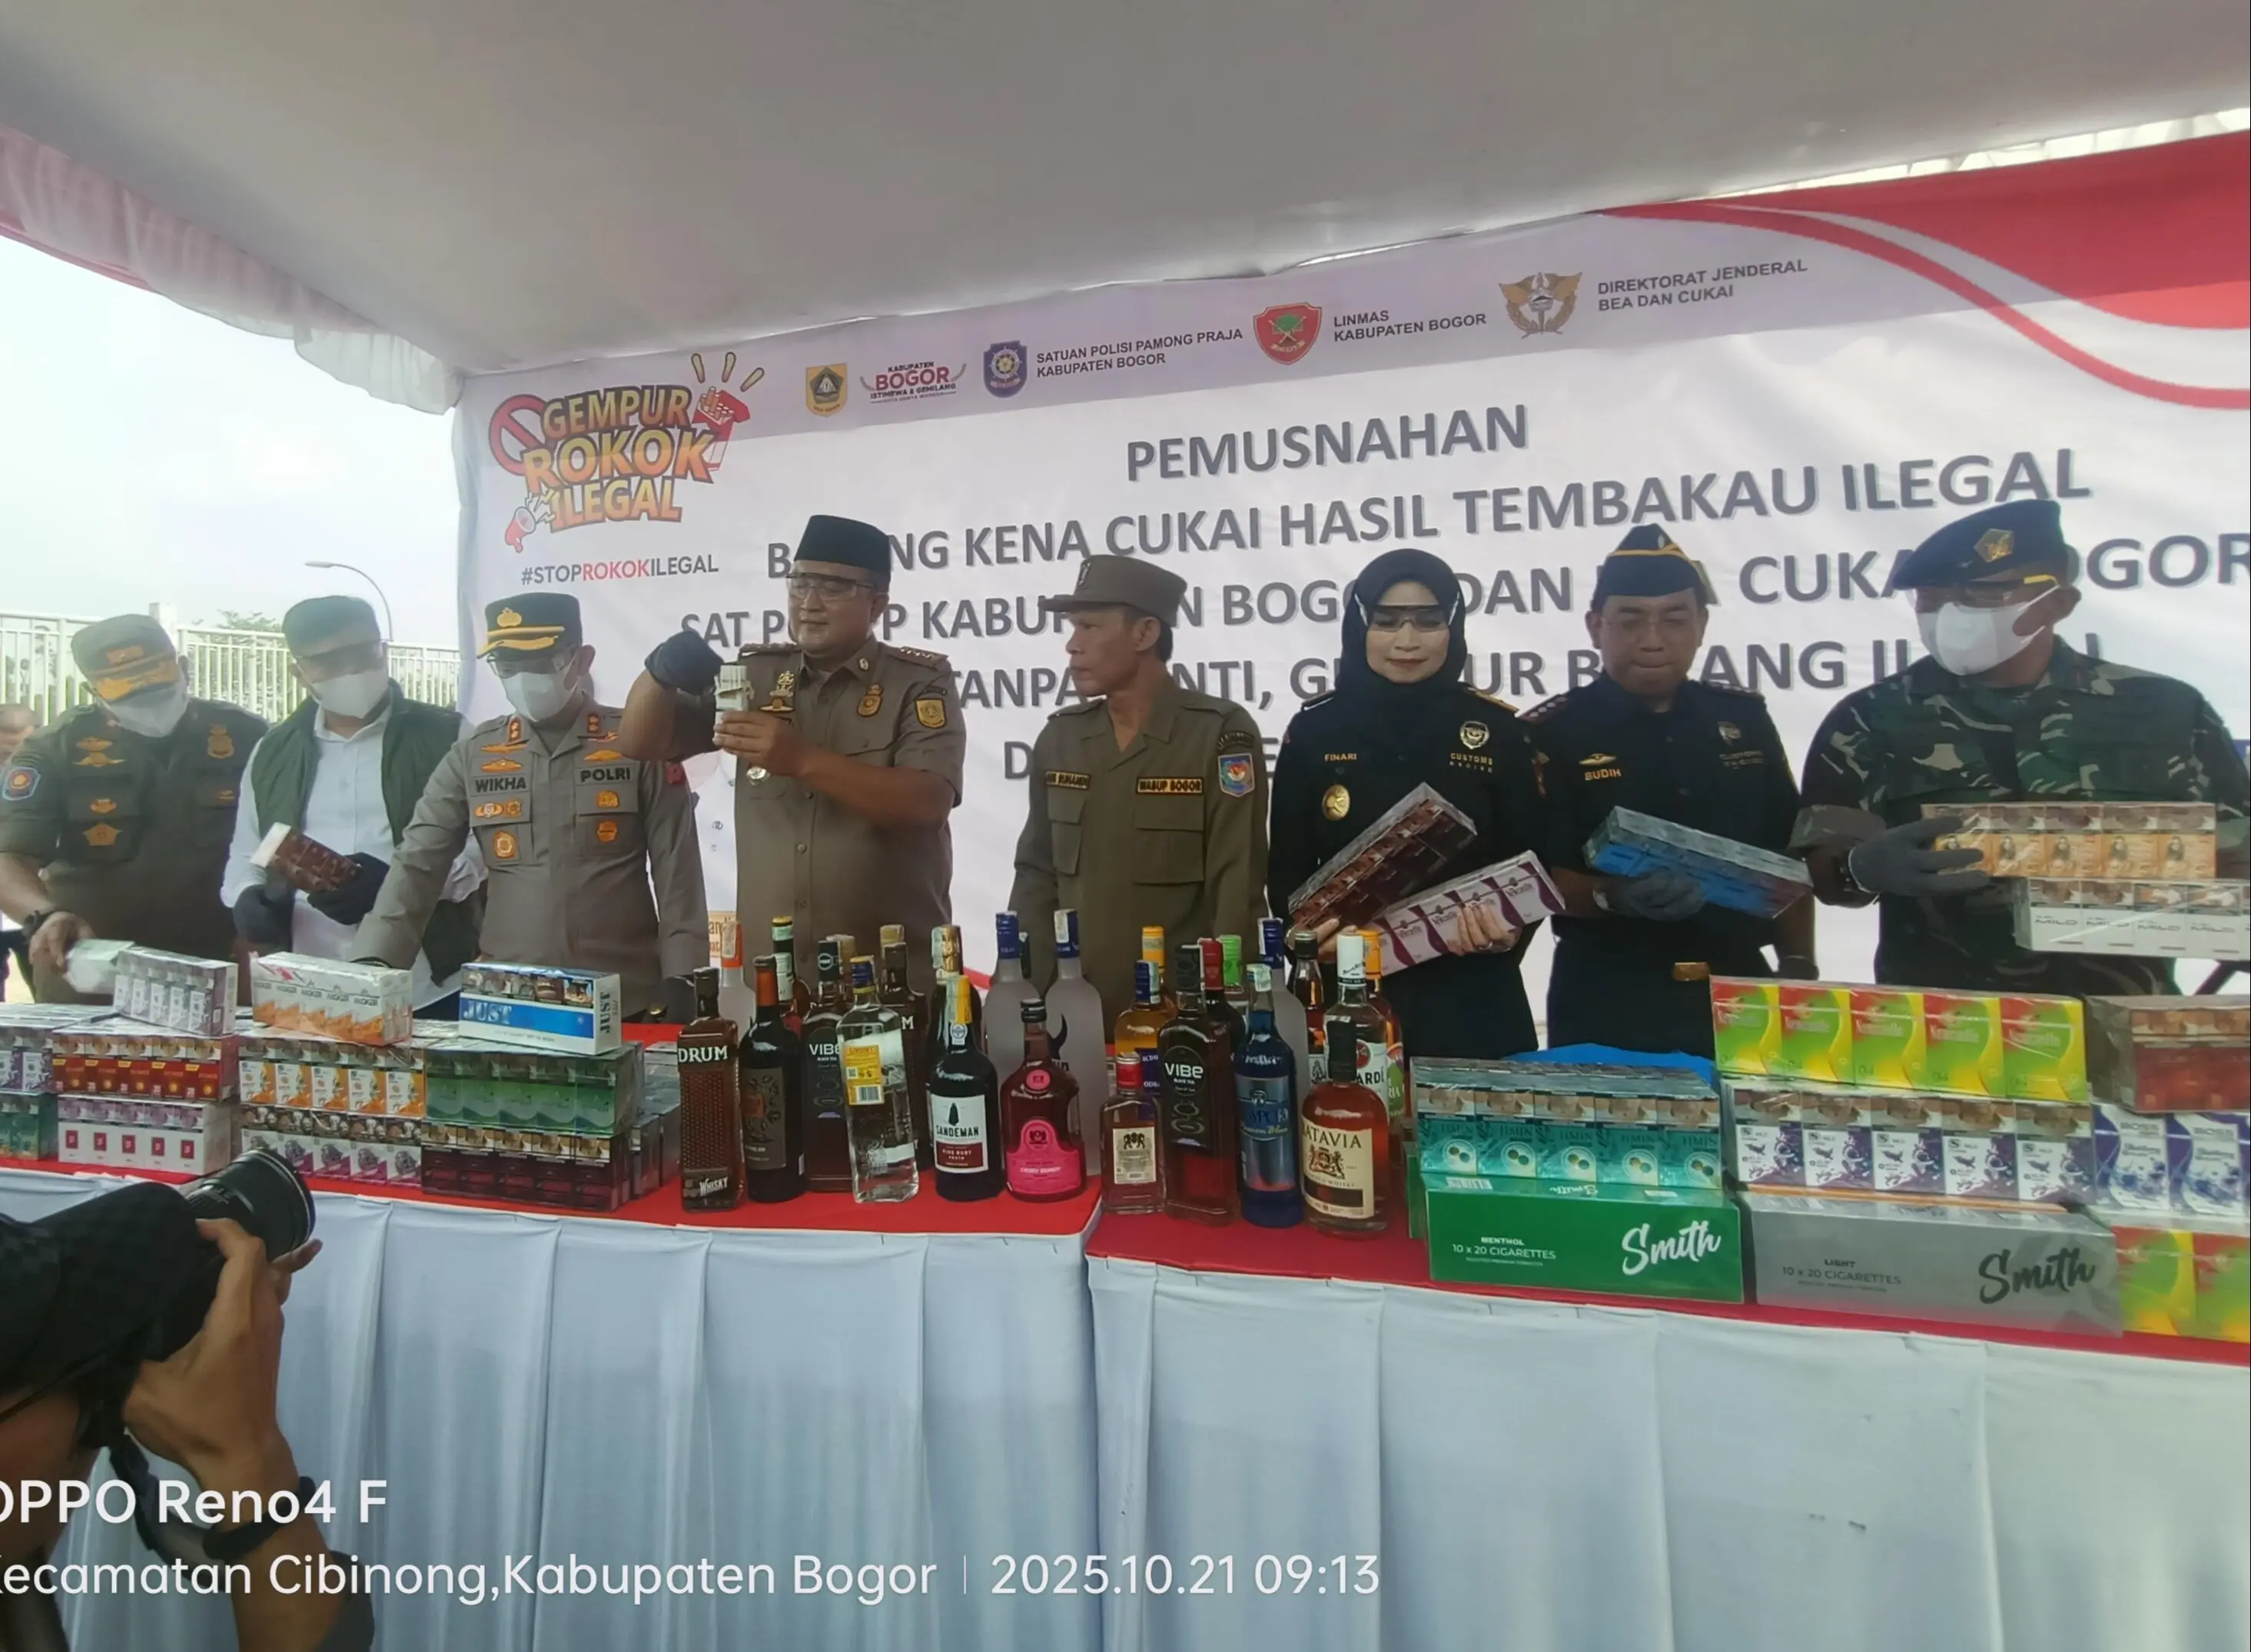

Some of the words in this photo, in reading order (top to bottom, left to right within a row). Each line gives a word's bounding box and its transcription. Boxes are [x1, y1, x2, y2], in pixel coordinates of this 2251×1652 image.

[1598, 271, 1707, 294] DIREKTORAT
[1712, 260, 1808, 281] JENDERAL
[1599, 296, 1633, 311] BEA
[1638, 292, 1672, 307] DAN
[1678, 285, 1734, 304] CUKAI
[1334, 310, 1389, 327] LINMAS
[1334, 322, 1423, 342] KABUPATEN
[1429, 313, 1486, 331] BOGOR
[1038, 349, 1087, 363] SATUAN
[1091, 342, 1132, 357] POLISI
[1136, 333, 1193, 352] PAMONG
[1197, 328, 1243, 343] PRAJA
[888, 361, 934, 372] KABUPATEN
[1038, 360, 1113, 377] KABUPATEN
[1117, 353, 1166, 368] BOGOR
[876, 367, 950, 391] BOGOR
[543, 385, 692, 439] GEMPUR
[1127, 405, 1528, 481] PEMUSNAHAN
[523, 428, 716, 493] ROKOK
[549, 476, 682, 532] ILEGAL
[966, 522, 1091, 566] KENA
[1107, 508, 1260, 556] CUKAI
[1280, 495, 1438, 546] HASIL
[1453, 466, 1818, 535] TEMBAKAU
[1842, 449, 2090, 510] ILEGAL
[521, 554, 719, 585] #STOPROKOKILEGAL
[1223, 579, 1356, 625] BOG
[1325, 753, 1357, 761] FINARI
[475, 776, 527, 793] WIKHA
[580, 768, 631, 782] POLRI
[1170, 779, 1201, 792] BOGOR
[463, 999, 513, 1025] JUST
[599, 991, 611, 1033] JUST
[678, 1045, 728, 1063] DRUM
[936, 1125, 979, 1137] SANDEMAN
[1303, 1123, 1362, 1149] ATAVIA
[1453, 1243, 1463, 1253] 10
[1476, 1246, 1487, 1255] 20
[1489, 1246, 1556, 1260] CIGARETTES
[1481, 1236, 1526, 1246] MENTHOL
[1622, 1220, 1721, 1275] Smith
[1782, 1266, 1794, 1276] 10
[1808, 1269, 1821, 1279] 20
[1824, 1270, 1902, 1285] CIGARETTES
[1824, 1259, 1856, 1268] LIGHT
[1978, 1248, 2096, 1305] Smith
